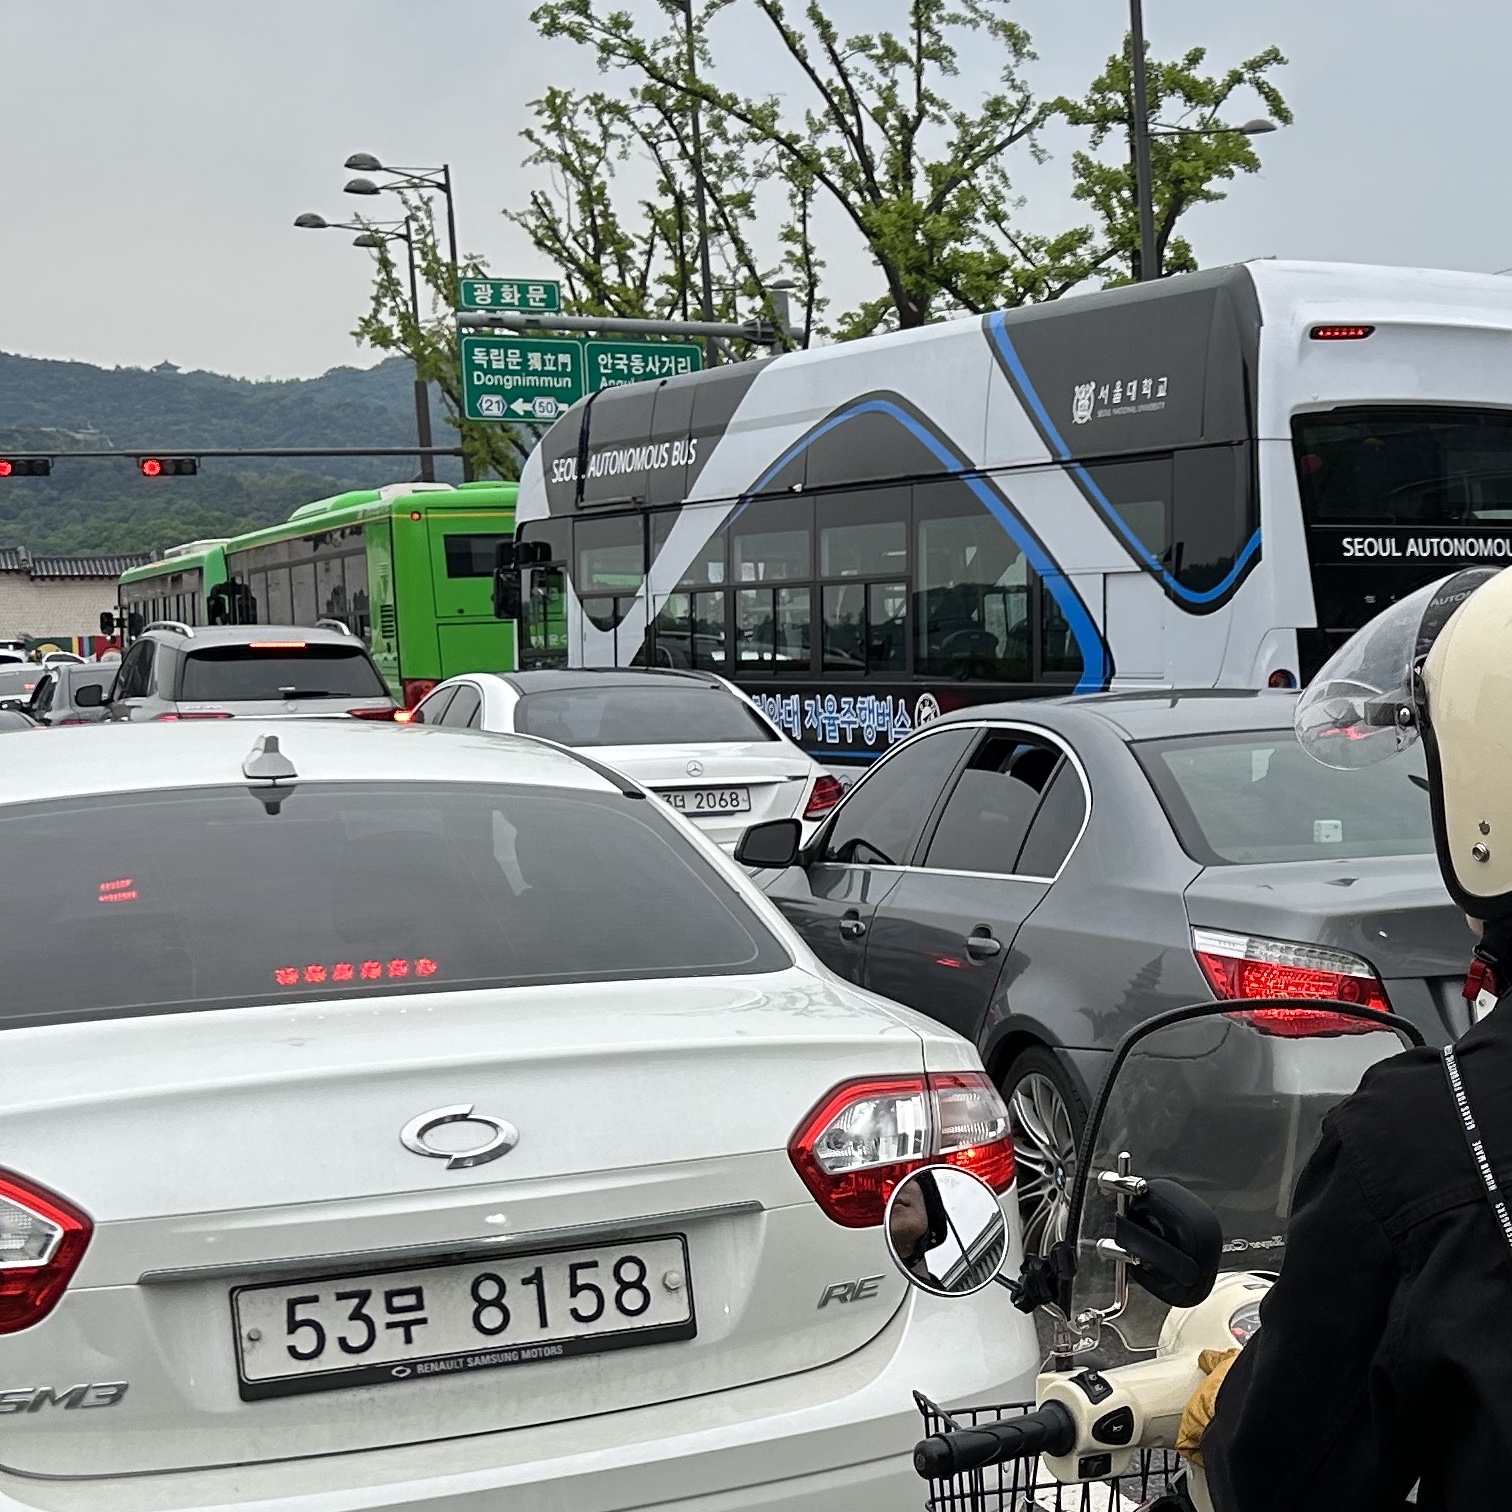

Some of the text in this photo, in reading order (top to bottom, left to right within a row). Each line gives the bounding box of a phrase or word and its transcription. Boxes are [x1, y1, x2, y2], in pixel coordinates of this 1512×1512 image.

[473, 283, 548, 307] 광화문
[472, 347, 523, 371] 독립문
[597, 352, 692, 376] 안국동사거리
[473, 370, 572, 390] Dongnimmun
[484, 399, 501, 412] 21
[538, 400, 554, 414] 50
[587, 442, 670, 479] AUTONOMOUS
[671, 438, 698, 467] BUS
[1341, 537, 1402, 557] SEOUL
[804, 693, 913, 746] 자율주행버스
[694, 791, 740, 810] 2068
[817, 1272, 887, 1310] RE
[286, 1254, 652, 1362] 53무 8158
[416, 1344, 564, 1375] RENAULT SAMSUNG MOTORS
[0, 1380, 129, 1414] SM3
